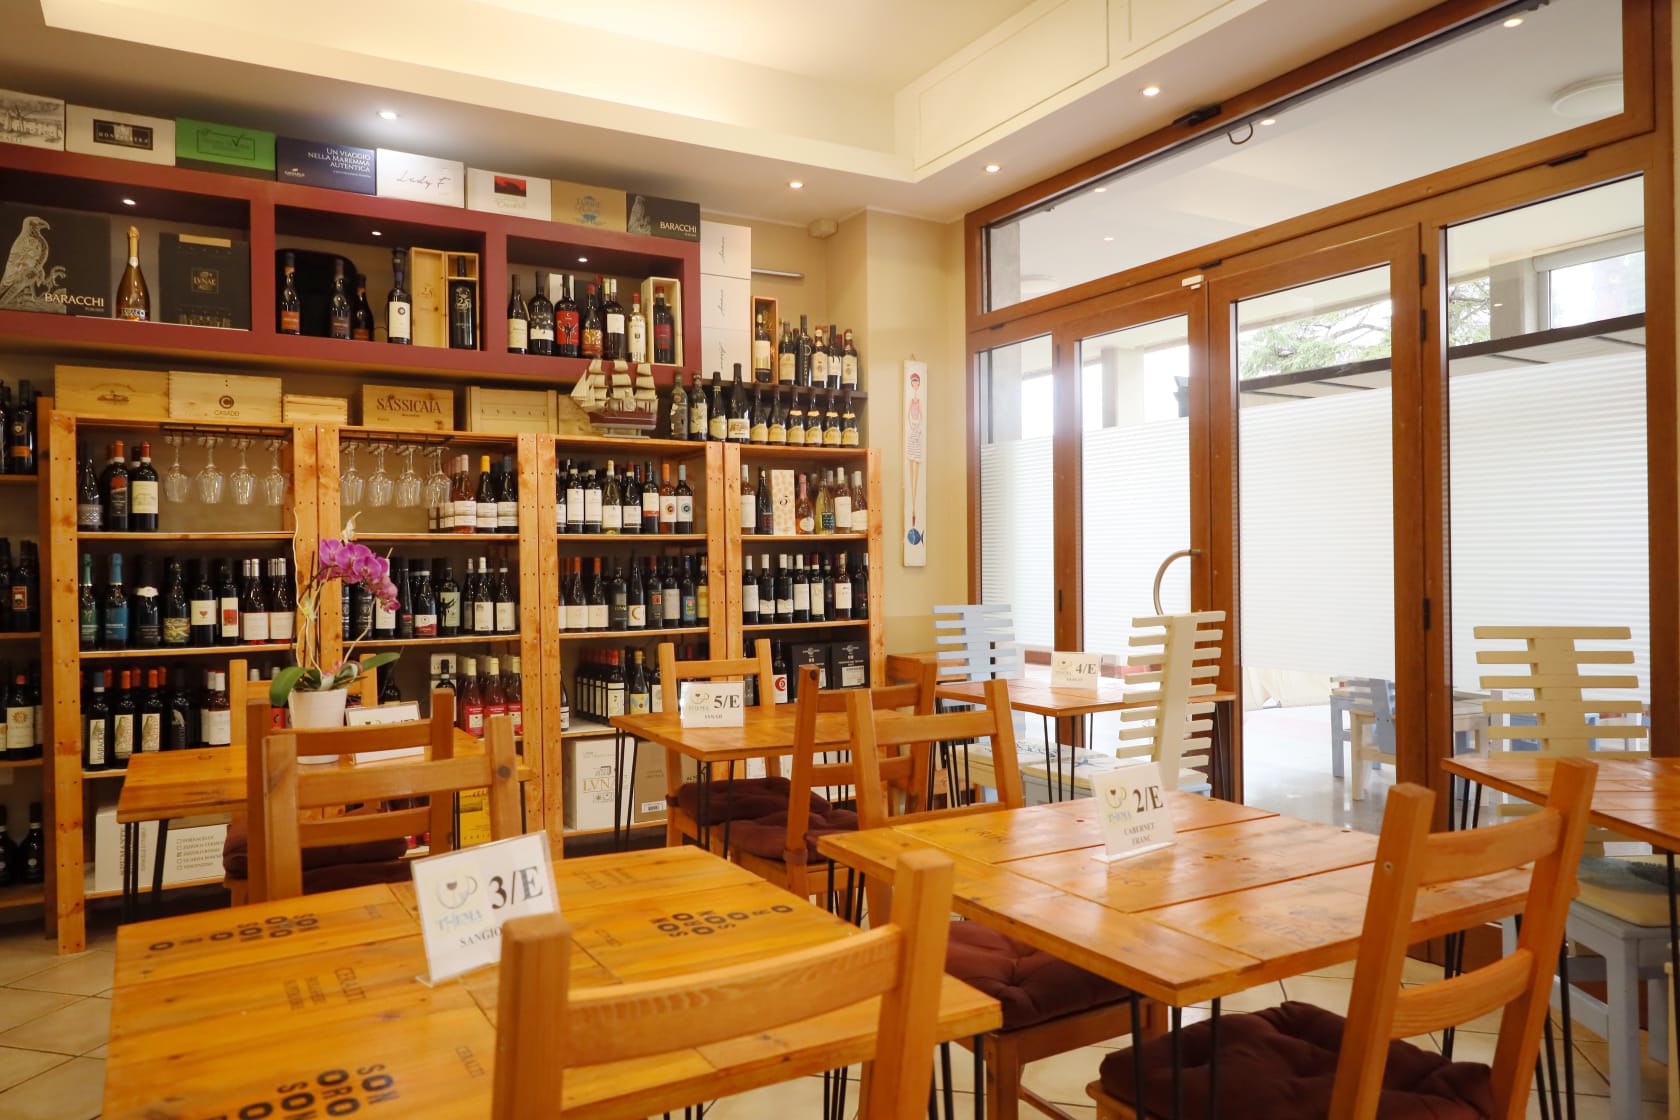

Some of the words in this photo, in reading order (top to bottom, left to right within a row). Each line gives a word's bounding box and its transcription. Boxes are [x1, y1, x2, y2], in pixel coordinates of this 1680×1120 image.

[307, 152, 331, 161] NELLA
[332, 155, 371, 167] MAREMMA
[326, 147, 338, 156] UN
[340, 150, 371, 161] VIAGGIO
[330, 161, 371, 173] AUTENTICA
[660, 221, 697, 233] BARACCHI
[44, 293, 105, 307] BARACCHI
[376, 398, 441, 413] SASSICAIA
[1075, 663, 1097, 674] 4/E
[713, 694, 740, 709] 5/E
[1133, 785, 1164, 813] 2/E
[1124, 822, 1155, 836] CABERNET
[1132, 835, 1152, 846] FRANC
[489, 866, 544, 910] 3/E
